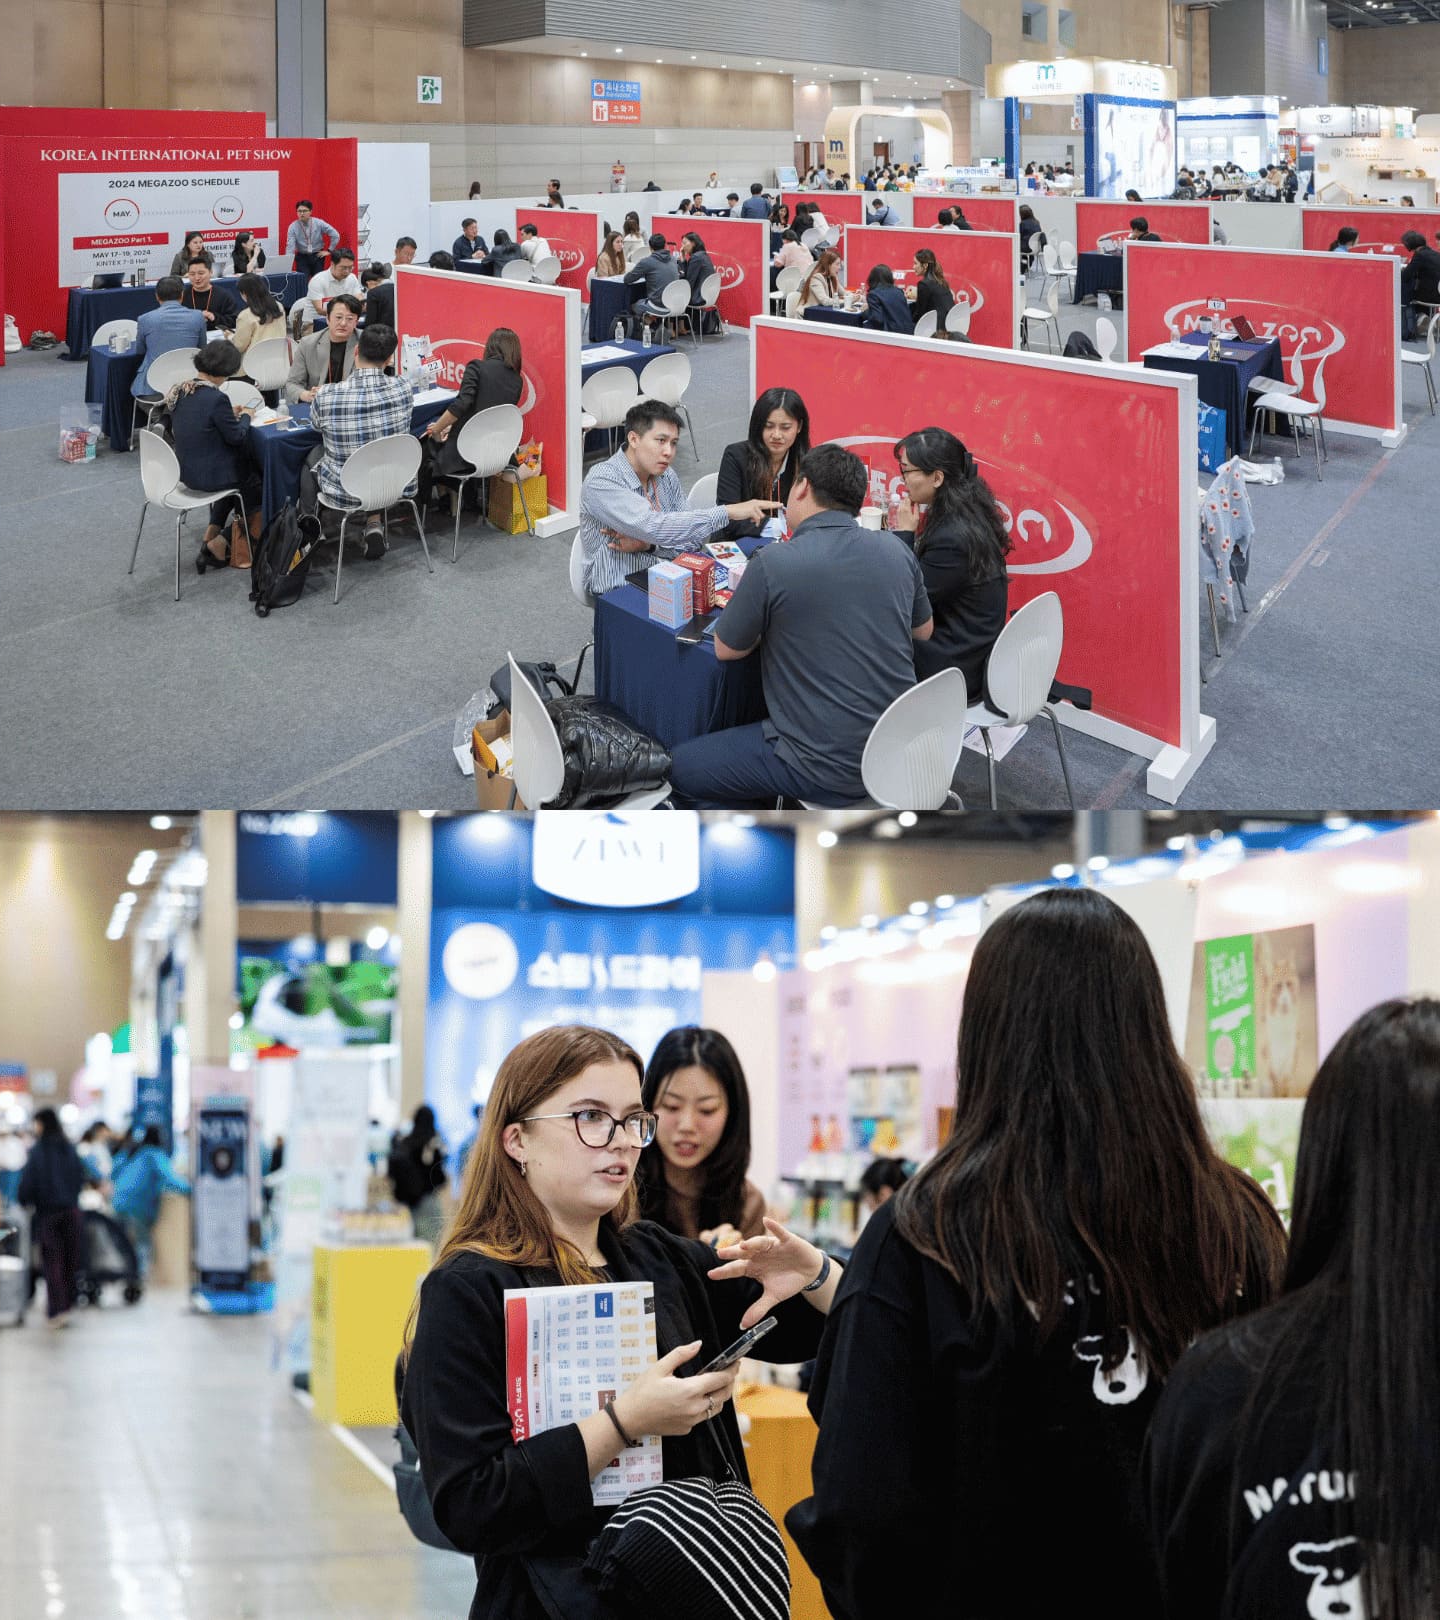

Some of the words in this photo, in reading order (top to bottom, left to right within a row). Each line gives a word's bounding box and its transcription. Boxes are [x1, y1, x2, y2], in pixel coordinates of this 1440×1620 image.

[40, 149, 97, 161] KOREA
[101, 149, 224, 161] INTERNATIONAL
[226, 149, 250, 161] PET
[253, 149, 293, 160] SHOW
[108, 180, 136, 188] 2024
[138, 179, 189, 188] MEGAZOO
[191, 178, 241, 187] SCHEDULE
[112, 210, 132, 218] MAY.
[91, 238, 129, 246] MEGAZOO
[93, 251, 109, 259] MAY
[427, 361, 439, 371] 22
